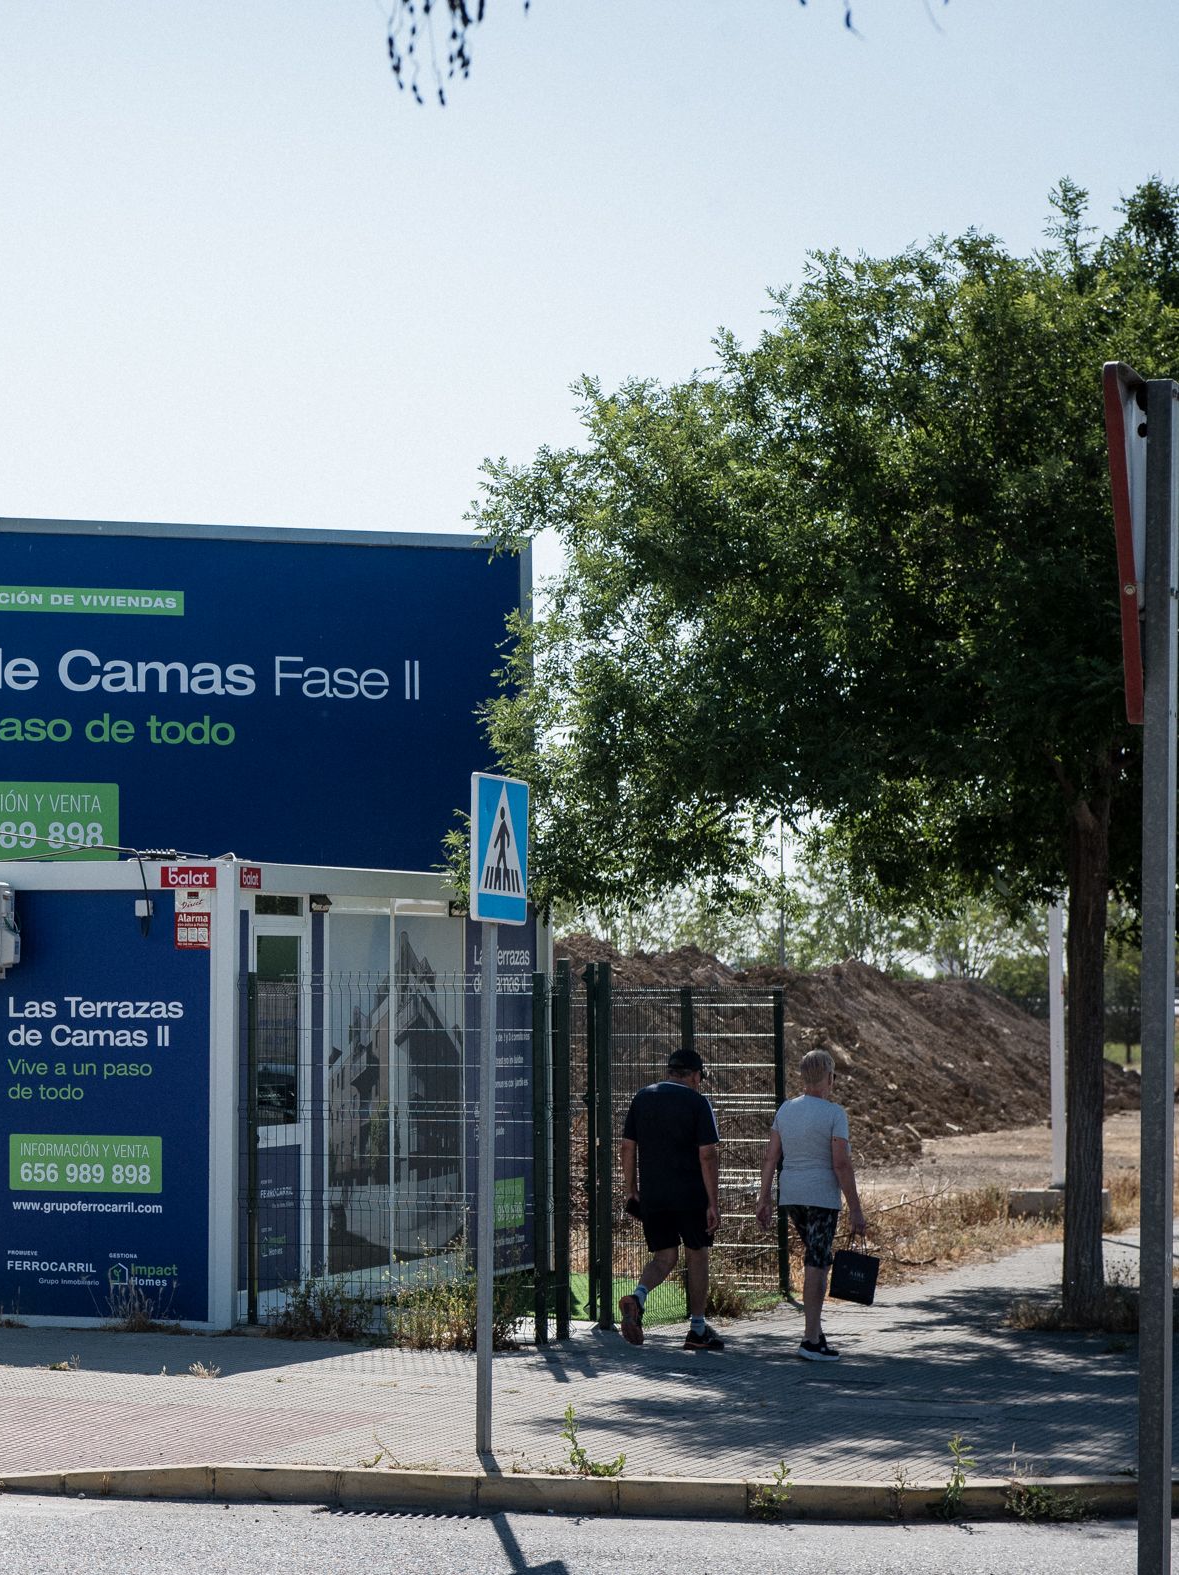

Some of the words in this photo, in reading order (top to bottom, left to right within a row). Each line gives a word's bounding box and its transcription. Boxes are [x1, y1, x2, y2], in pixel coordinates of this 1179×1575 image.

[50, 594, 74, 606] DE
[80, 594, 177, 609] VIVIENDAS
[58, 649, 256, 696] Camas
[274, 656, 389, 699] Fase
[405, 660, 419, 699] II
[85, 713, 134, 743] de
[147, 715, 236, 746] todo
[34, 794, 44, 812] Y
[50, 794, 102, 813] VENTA
[48, 822, 104, 849] 898
[168, 867, 209, 885] balat
[178, 913, 208, 922] Alarma
[496, 945, 530, 966] errazas
[496, 976, 520, 993] amas
[8, 996, 57, 1018] Las
[64, 996, 184, 1018] Terrazas
[8, 1024, 42, 1046] de
[51, 1024, 148, 1047] Camas
[157, 1025, 170, 1047] II
[7, 1058, 48, 1075] Vive
[54, 1062, 67, 1076] a
[73, 1062, 96, 1076] un
[104, 1062, 153, 1080] paso
[8, 1083, 32, 1099] de
[39, 1084, 84, 1100] todo
[20, 1141, 99, 1158] INFORMACIÓN
[102, 1144, 110, 1157] Y
[113, 1144, 150, 1158] VENTA
[20, 1162, 59, 1183] 656
[65, 1163, 105, 1184] 989
[111, 1164, 151, 1185] 898
[12, 1201, 163, 1214] www.grupoferrocarril.com
[7, 1260, 97, 1273] FERROCARRIL
[131, 1263, 178, 1278] Impact
[38, 1277, 59, 1285] Grupo
[131, 1276, 167, 1287] Homes
